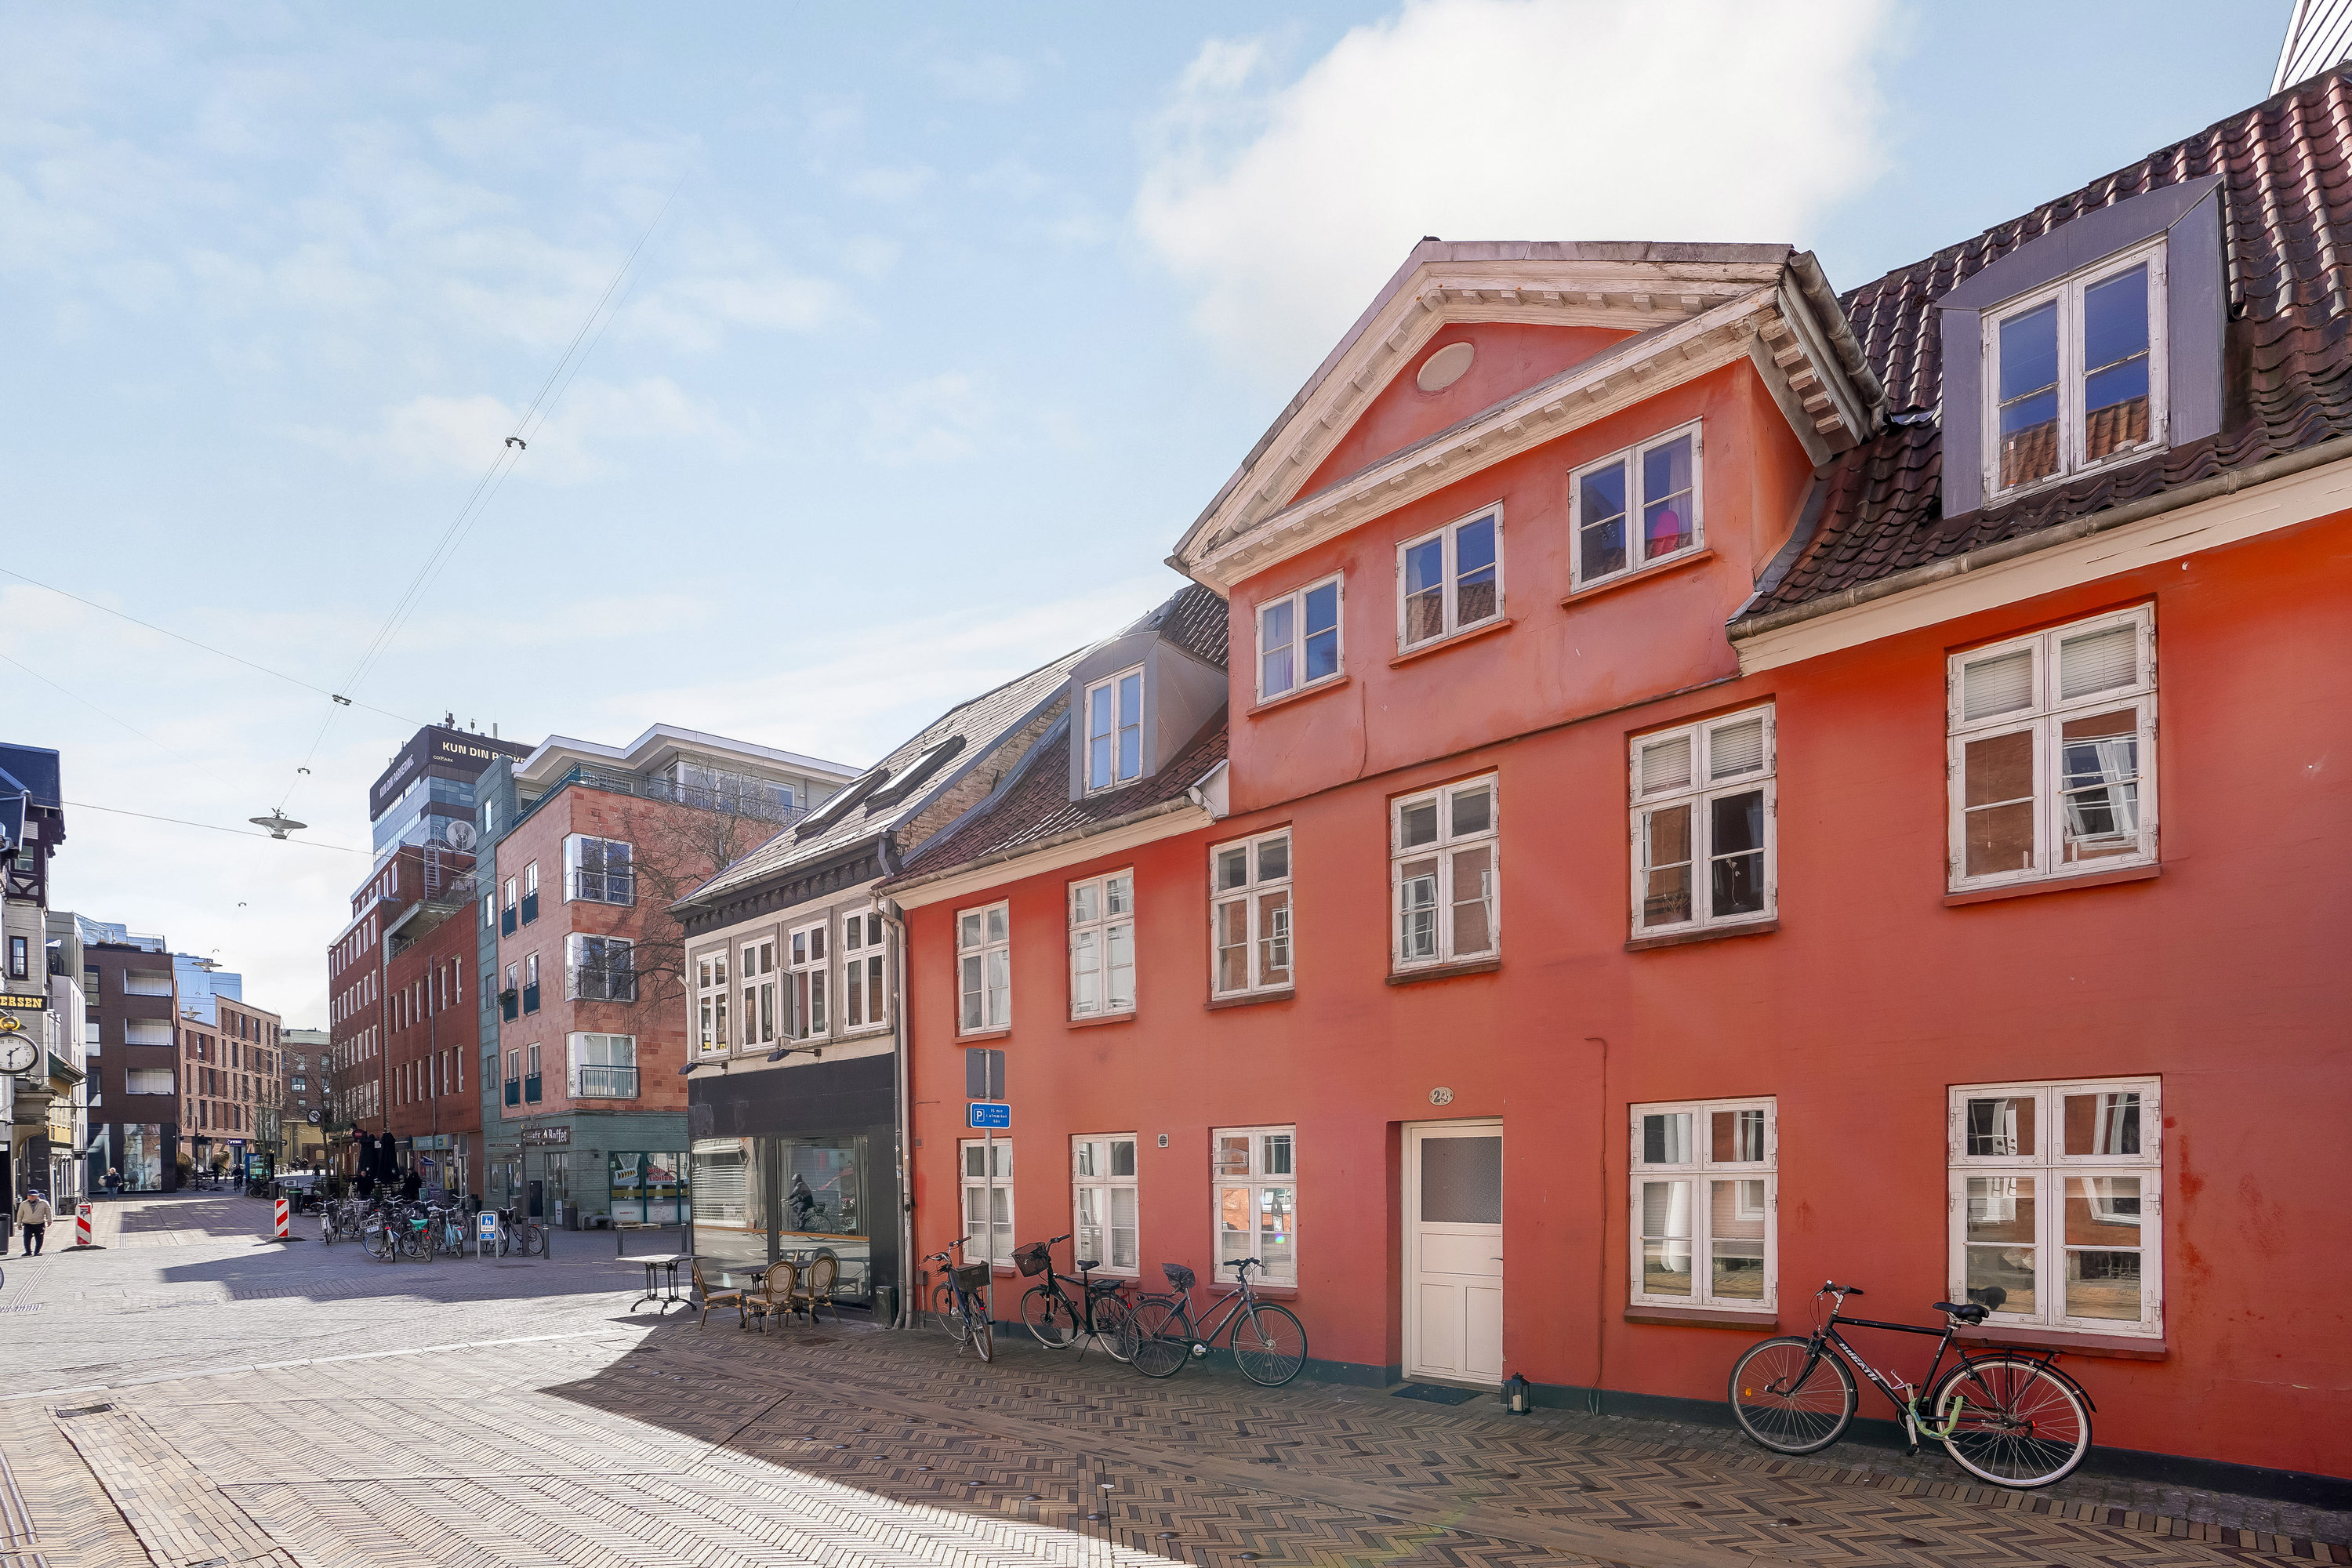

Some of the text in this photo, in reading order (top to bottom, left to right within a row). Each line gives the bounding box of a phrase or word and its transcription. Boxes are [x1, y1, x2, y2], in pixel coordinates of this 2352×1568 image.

[442, 741, 466, 754] KUN
[470, 747, 489, 760] DIN
[0, 996, 42, 1008] ERSEN
[1433, 1090, 1449, 1102] 24
[976, 1110, 983, 1120] P
[1838, 1343, 1880, 1381] BUGATTI
